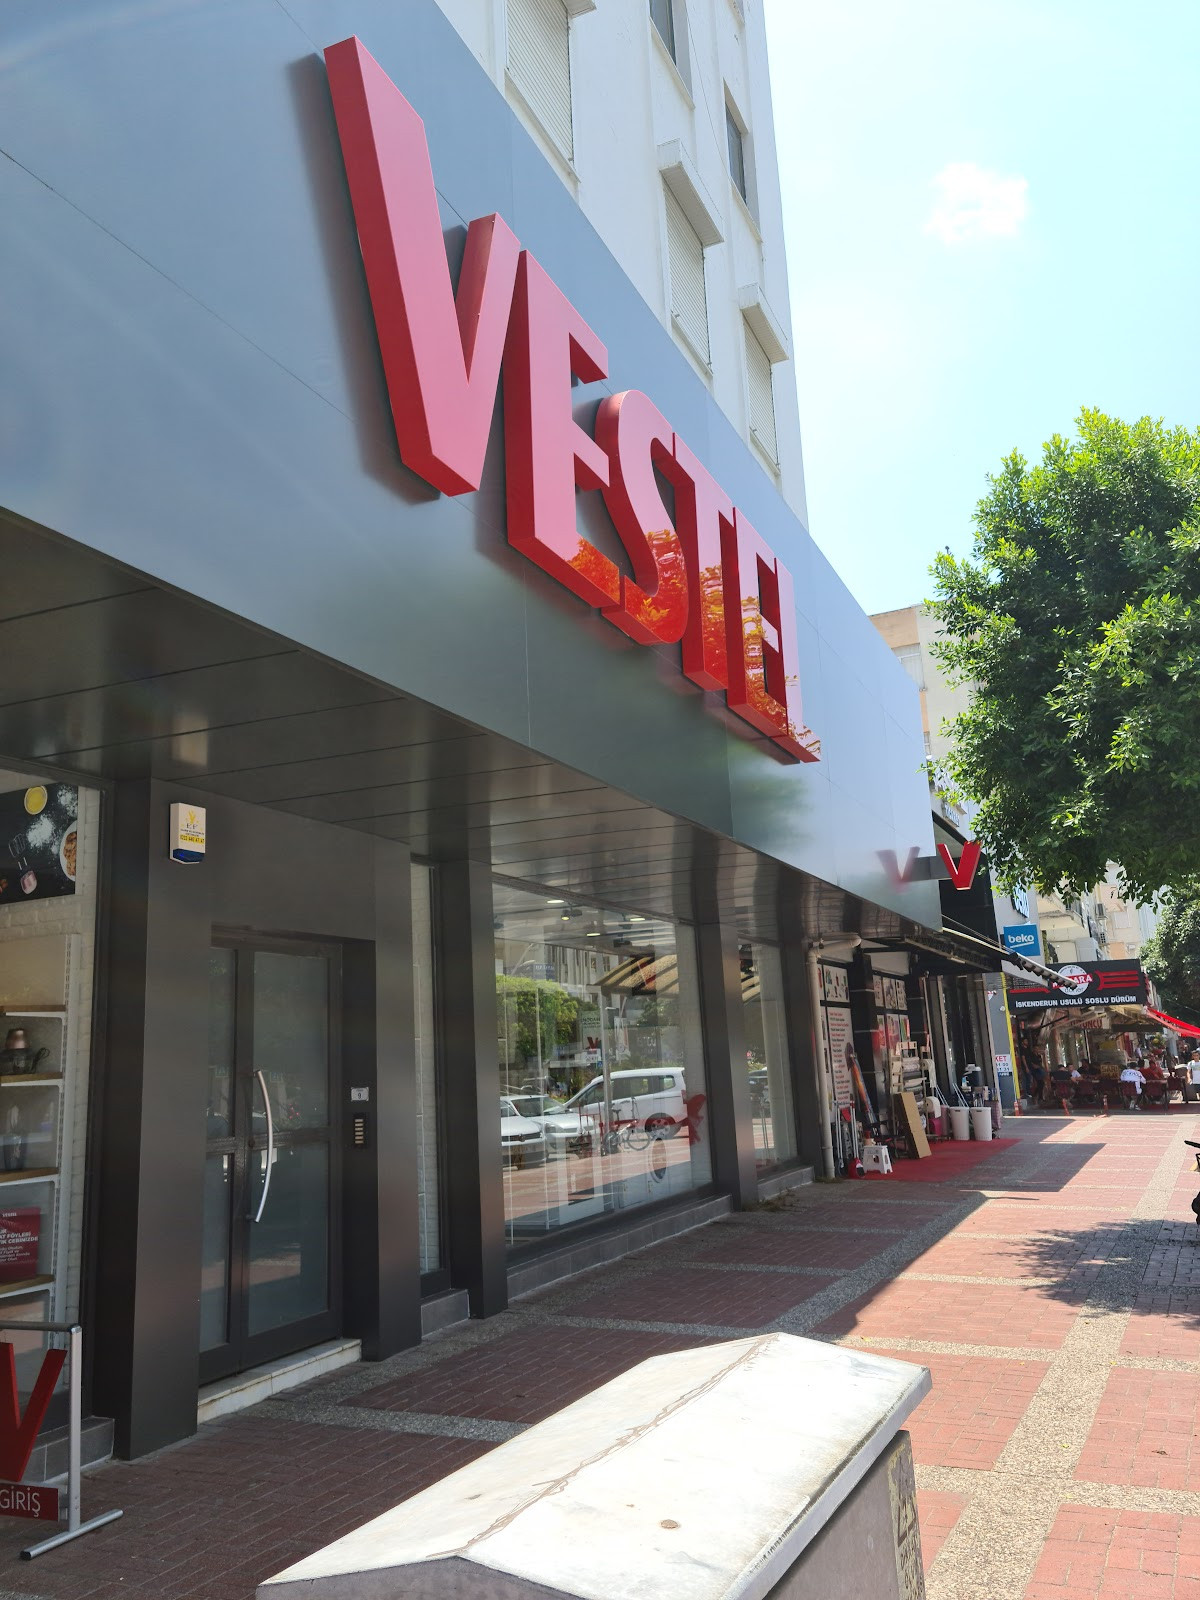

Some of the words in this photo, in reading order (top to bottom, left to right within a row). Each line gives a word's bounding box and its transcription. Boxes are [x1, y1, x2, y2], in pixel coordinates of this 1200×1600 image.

[324, 35, 821, 764] VESTEL
[1008, 934, 1034, 944] beko
[1015, 999, 1058, 1008] İSKENDERUN
[1060, 997, 1083, 1006] USULÜ
[1085, 997, 1109, 1005] SOSLU
[1110, 995, 1137, 1003] DÜRÜM
[0, 1485, 41, 1518] GİRİŞ
